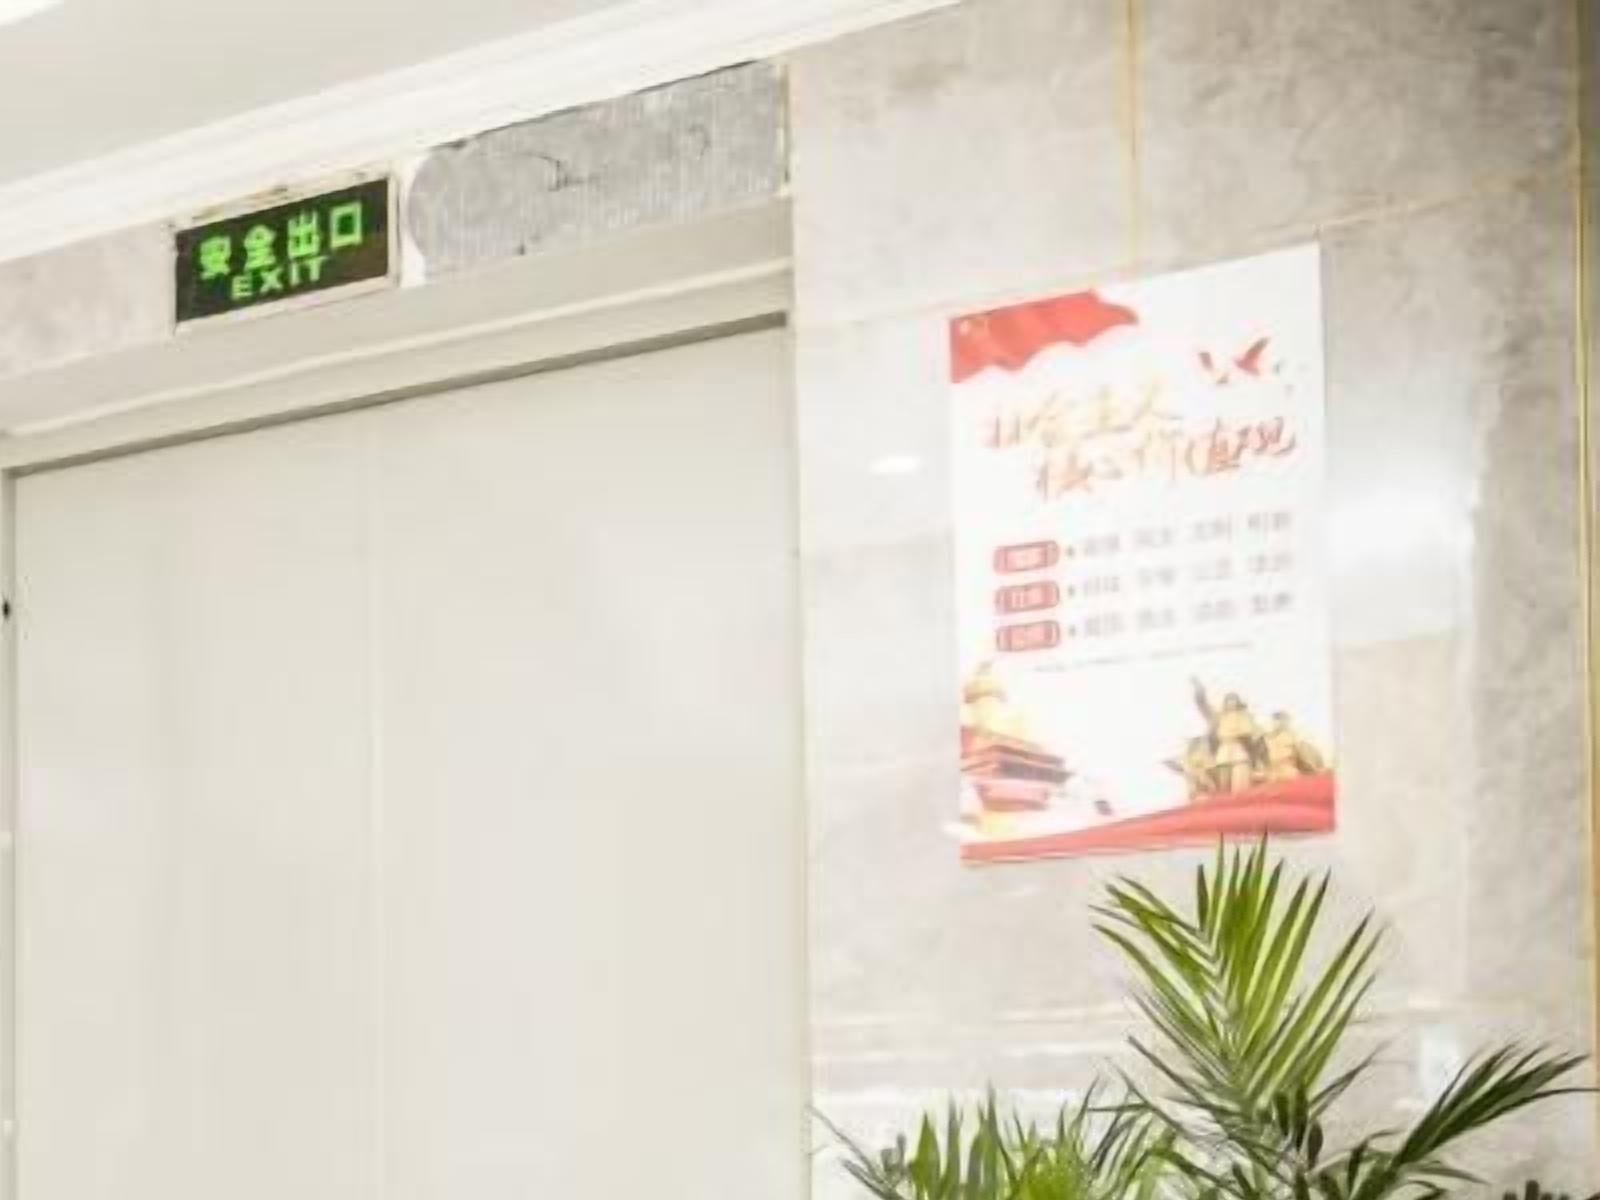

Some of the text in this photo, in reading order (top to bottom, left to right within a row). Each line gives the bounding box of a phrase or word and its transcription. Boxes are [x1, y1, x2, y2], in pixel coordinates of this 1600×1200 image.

[200, 201, 363, 280] 安全出口
[231, 255, 328, 300] EXIT
